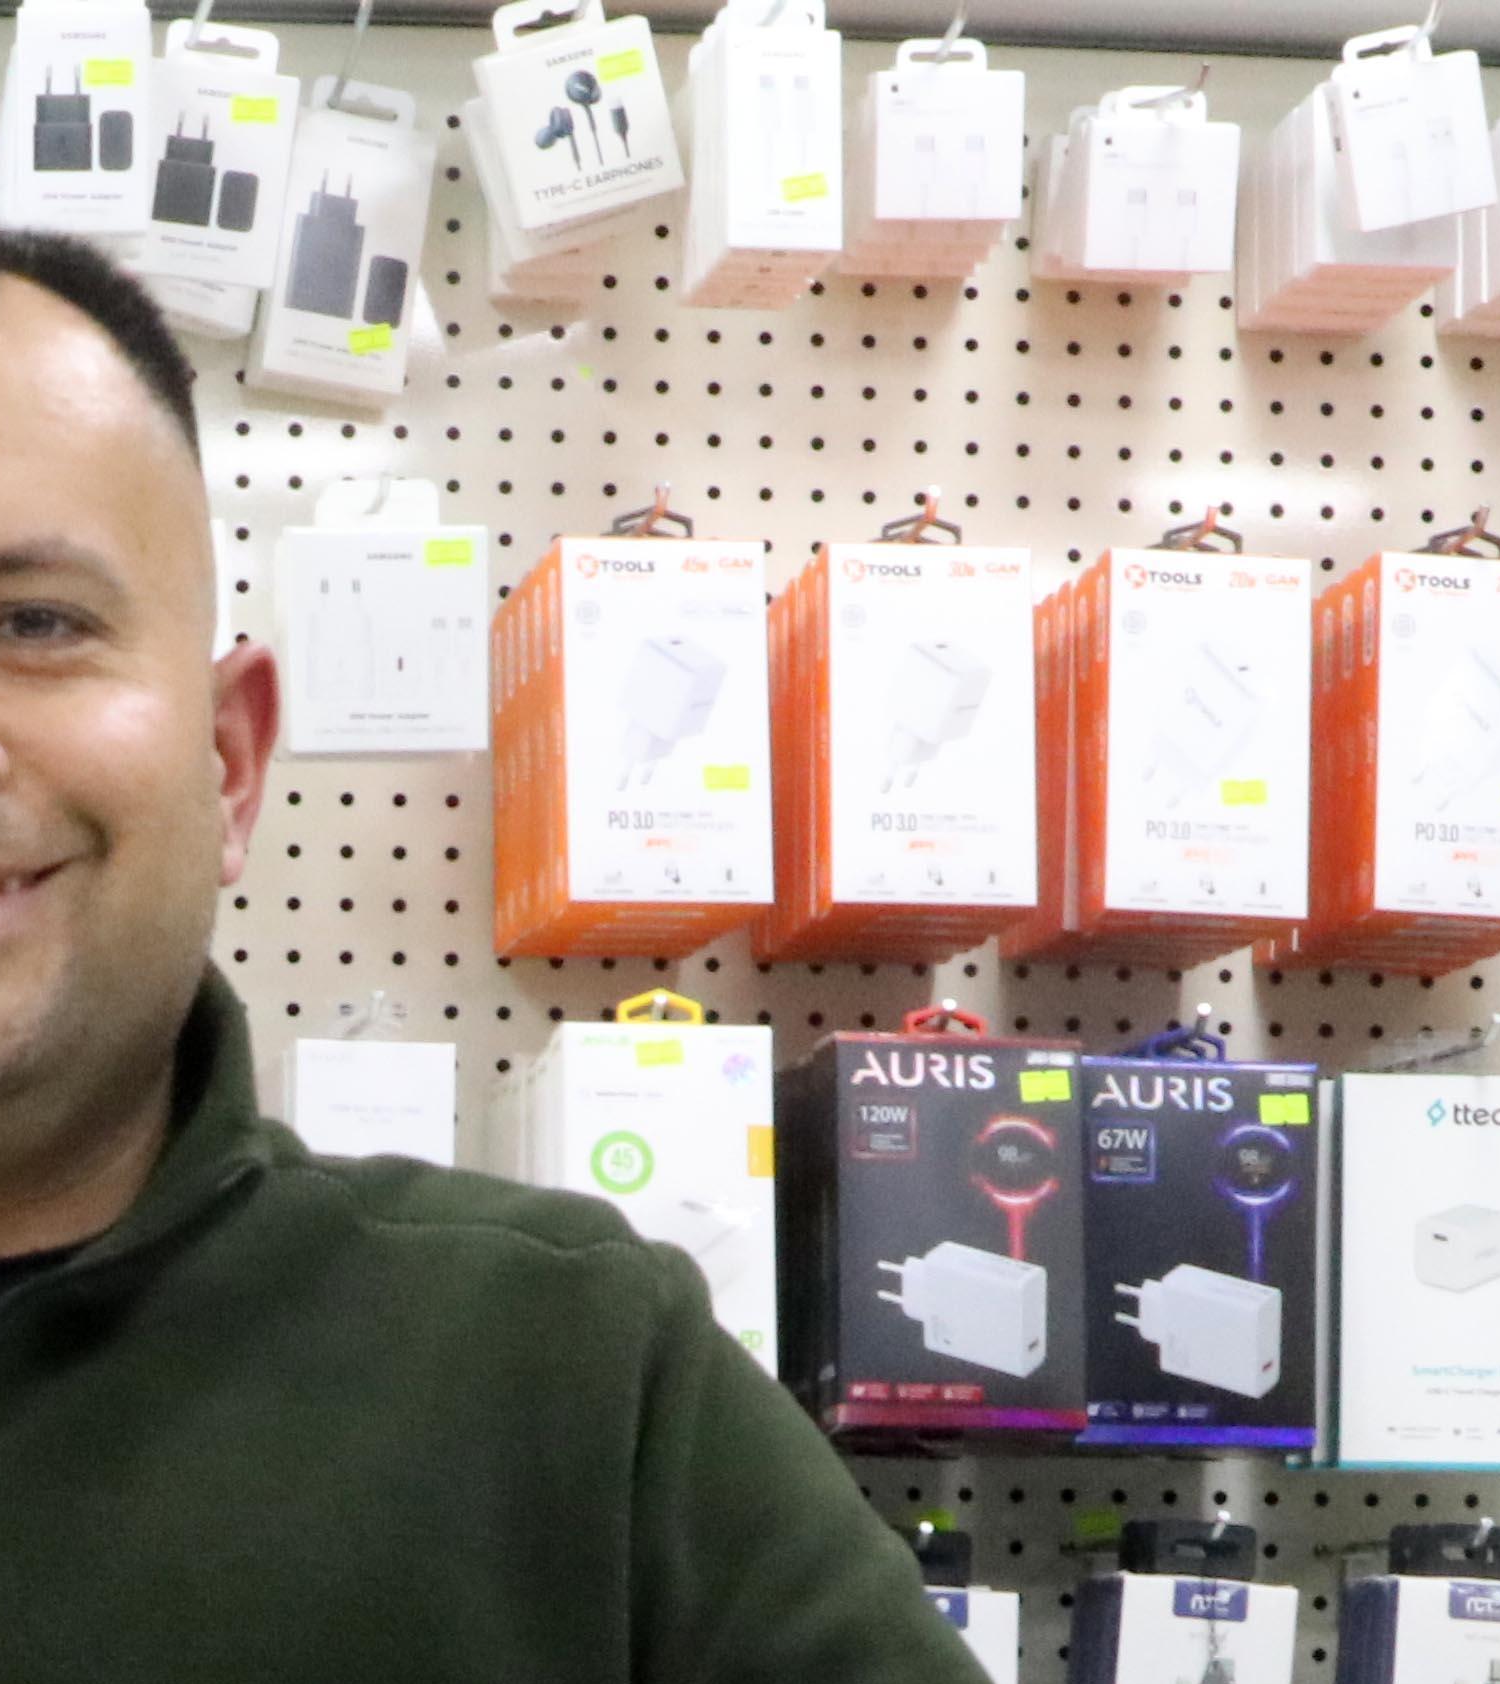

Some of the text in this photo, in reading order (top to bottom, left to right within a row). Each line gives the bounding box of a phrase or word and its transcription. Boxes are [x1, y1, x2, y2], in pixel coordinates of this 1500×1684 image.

[851, 1050, 996, 1091] AURIS
[1091, 1073, 1235, 1113] AURIS
[859, 1105, 908, 1123] 120W
[1097, 1128, 1148, 1150] 67W
